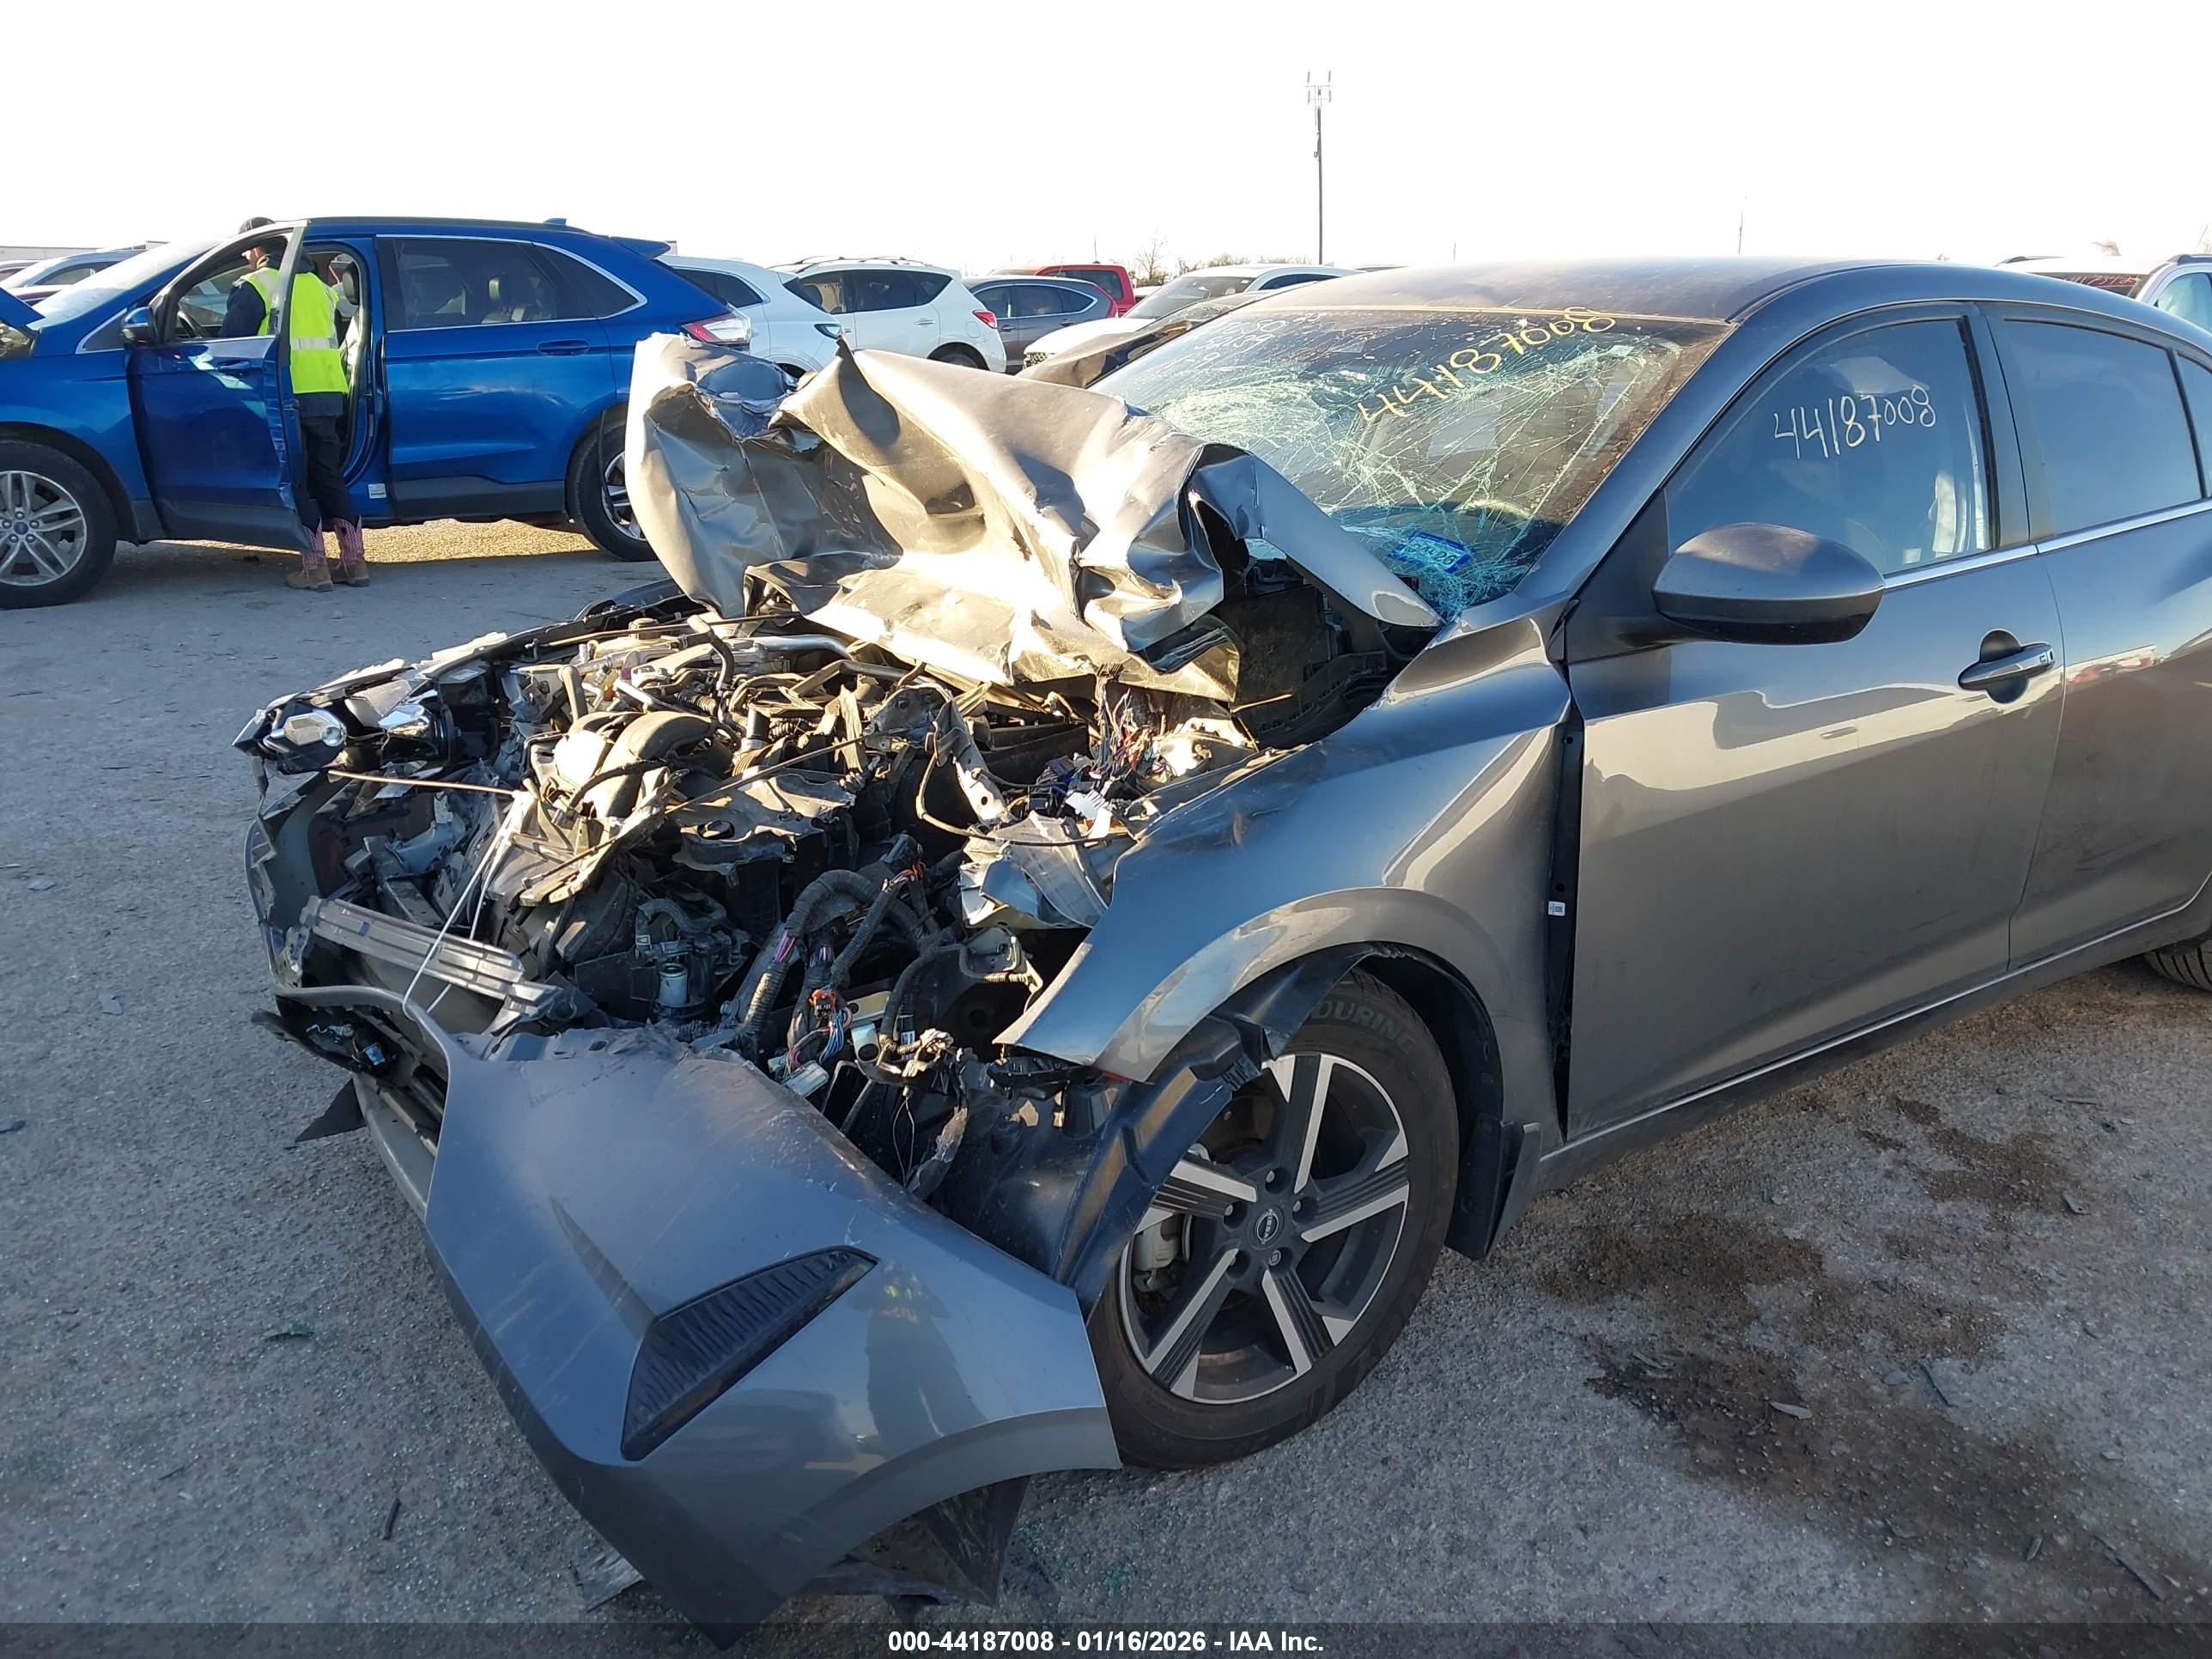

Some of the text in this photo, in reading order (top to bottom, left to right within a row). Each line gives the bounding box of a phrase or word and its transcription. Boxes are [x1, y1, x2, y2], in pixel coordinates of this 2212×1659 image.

[1358, 307, 1616, 422] 44187008
[1774, 384, 1936, 459] 44187008
[1310, 1000, 1417, 1054] OURING
